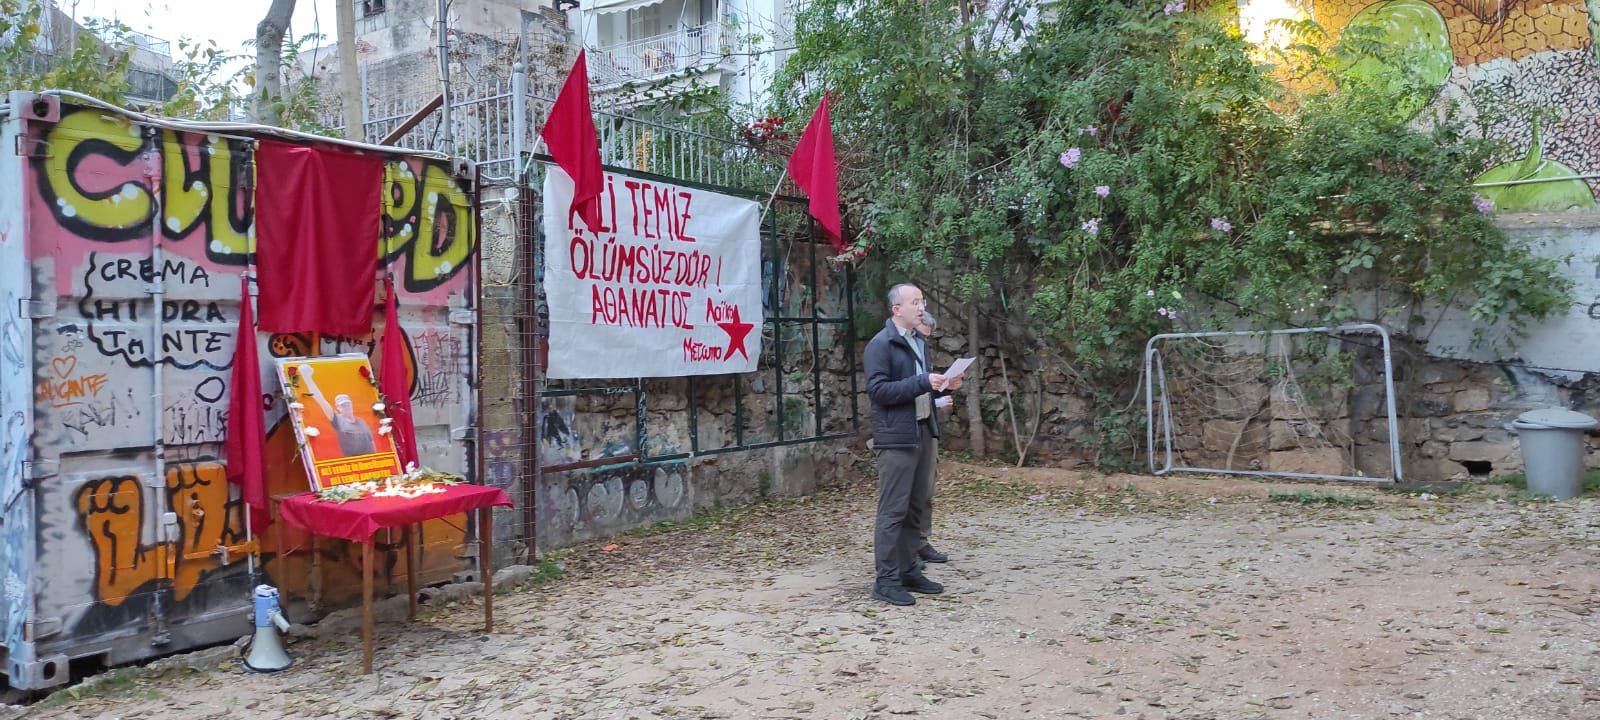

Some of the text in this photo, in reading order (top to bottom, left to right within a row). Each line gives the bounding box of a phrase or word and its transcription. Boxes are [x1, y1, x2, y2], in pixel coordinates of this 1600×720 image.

[625, 180, 696, 242] TEMİZ
[101, 257, 209, 287] CREMA
[592, 284, 694, 330] ΑΘΑΝΑΤΟΣ
